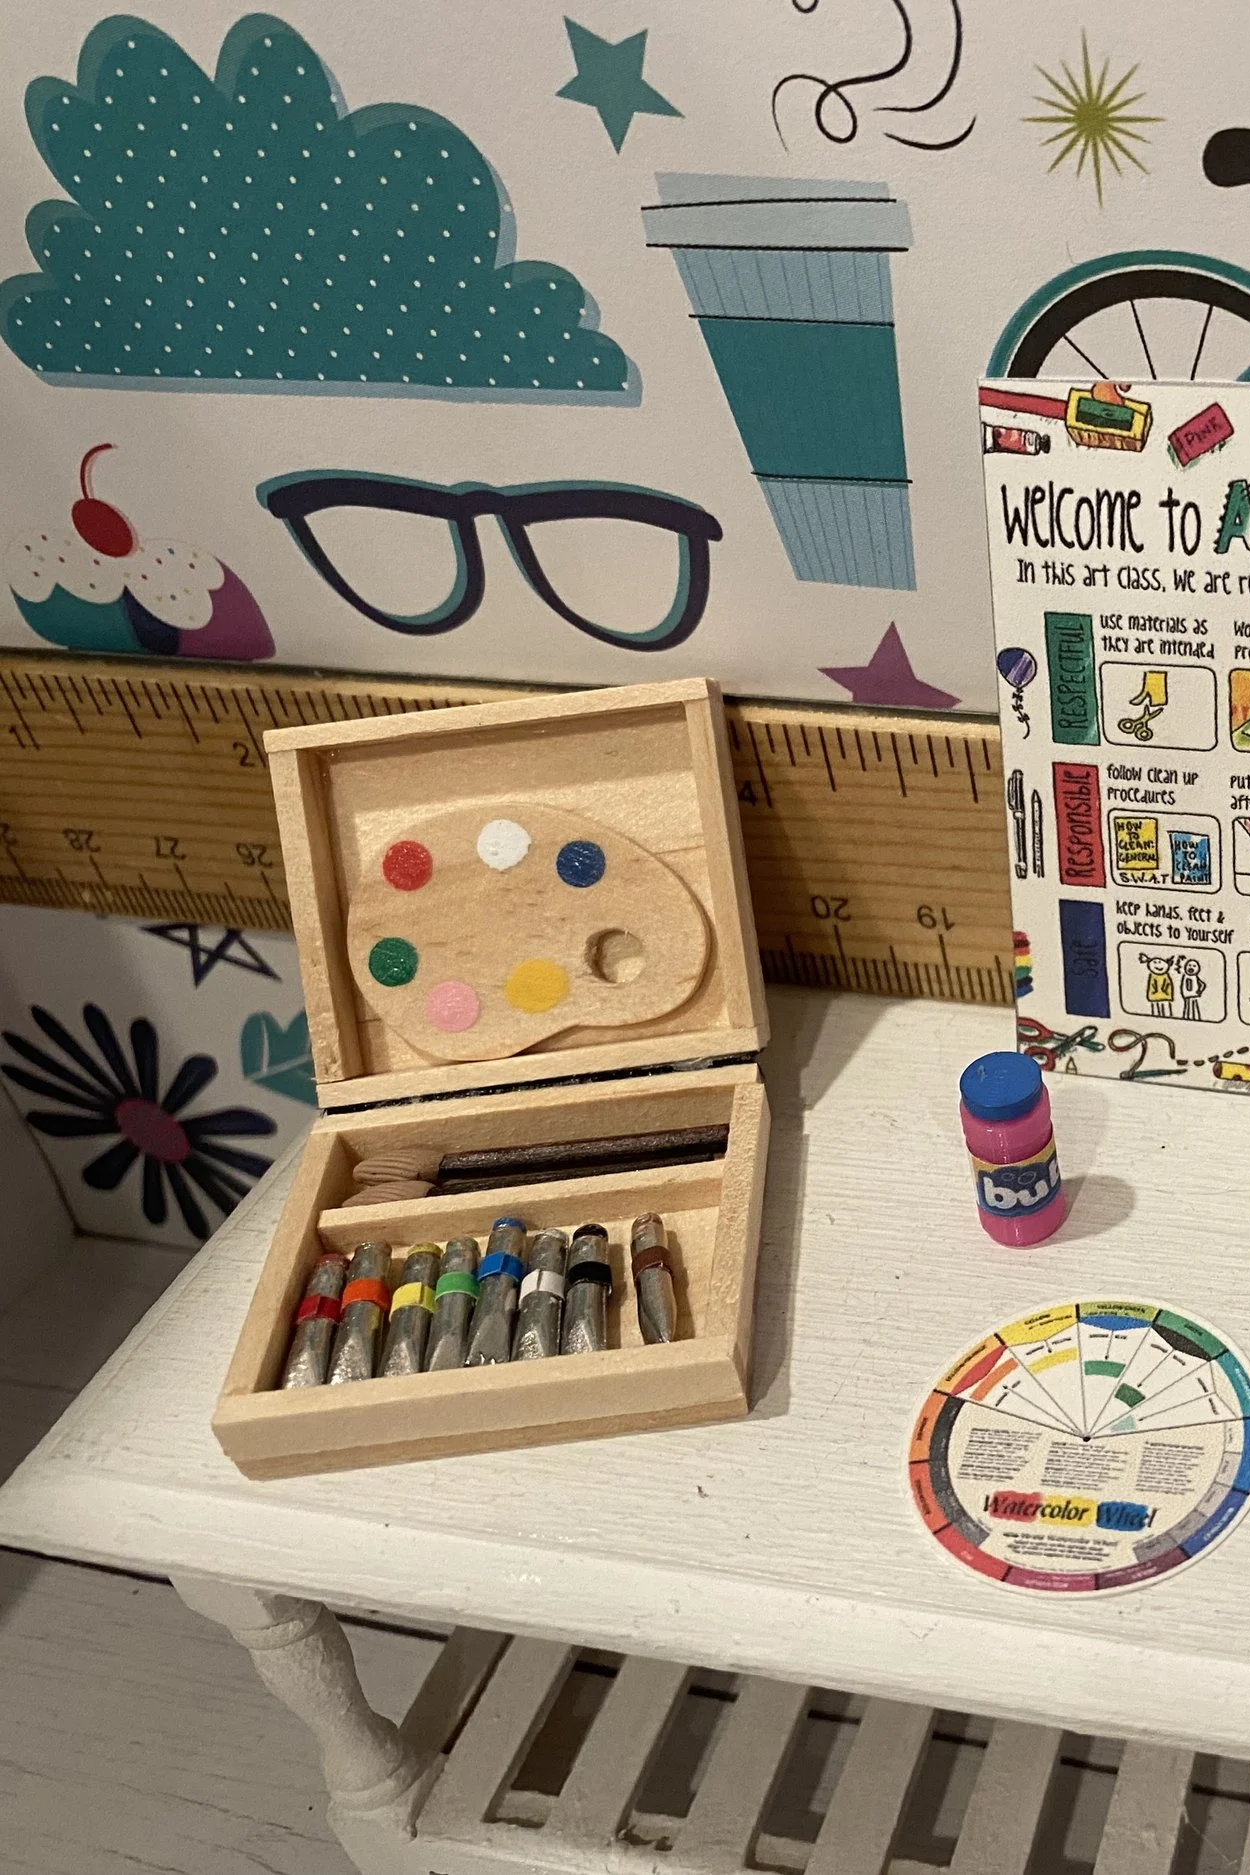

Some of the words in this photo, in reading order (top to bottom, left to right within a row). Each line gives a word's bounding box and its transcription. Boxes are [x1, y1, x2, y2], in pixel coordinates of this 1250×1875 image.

[1001, 480, 1144, 553] welcome
[1159, 487, 1201, 556] to
[1017, 558, 1035, 583] In
[1041, 562, 1075, 586] this
[1083, 564, 1110, 587] art
[1117, 565, 1166, 592] class,
[1174, 569, 1196, 593] we
[1204, 571, 1231, 595] are
[1100, 614, 1123, 630] use
[1128, 615, 1187, 634] materials
[1193, 619, 1208, 635] as
[1101, 635, 1129, 653] they
[1133, 638, 1154, 654] are
[1160, 639, 1214, 659] intended
[1054, 623, 1088, 729] RESPECTFUL
[9, 726, 26, 749] 1
[233, 741, 255, 767] 2
[1107, 763, 1142, 782] follow
[1147, 768, 1178, 784] clean
[1183, 772, 1199, 785] up
[738, 780, 758, 807] 4
[1107, 787, 1176, 805] procedures
[1117, 821, 1143, 832] HOW
[1127, 832, 1139, 841] TO
[63, 828, 100, 853] 28
[154, 836, 187, 860] 27
[1174, 840, 1198, 850] HOW
[235, 842, 273, 868] 26
[1184, 851, 1196, 860] TO
[811, 895, 852, 922] 20
[916, 904, 956, 932] 19
[1116, 900, 1141, 917] keep
[1187, 906, 1212, 922] feet
[1217, 910, 1225, 924] &
[1117, 920, 1162, 938] objects
[1167, 924, 1180, 939] to
[1186, 926, 1235, 944] yourself
[983, 1494, 1090, 1522] Watercolor
[1095, 1503, 1159, 1528] Wheel
